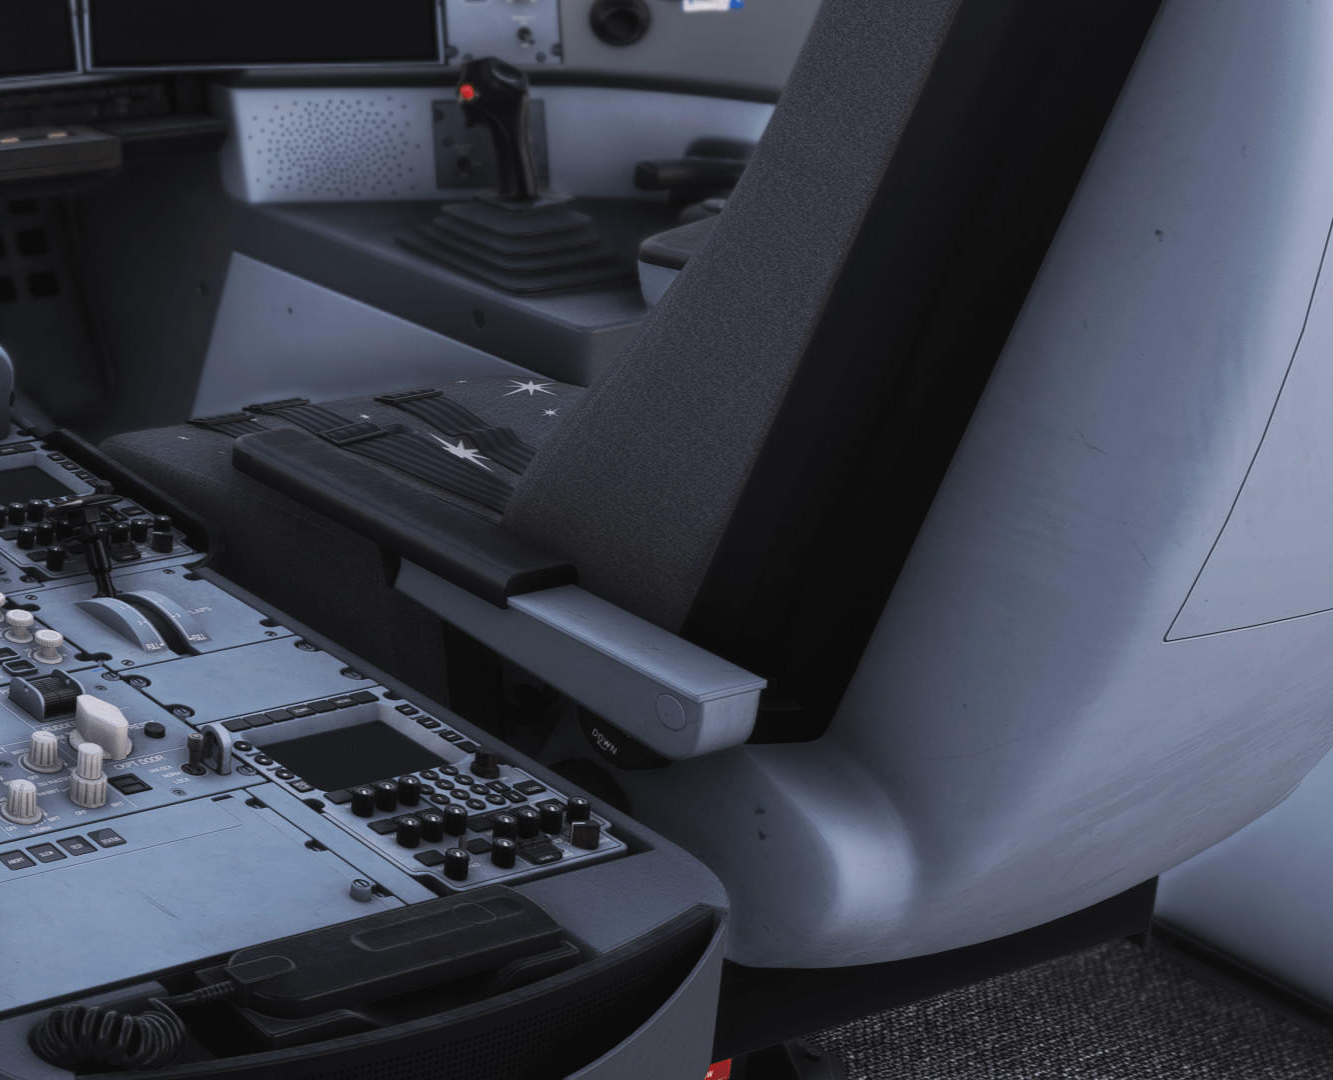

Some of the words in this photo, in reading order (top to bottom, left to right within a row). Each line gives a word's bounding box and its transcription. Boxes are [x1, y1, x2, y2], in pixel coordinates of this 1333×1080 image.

[145, 642, 162, 650] FULL
[592, 728, 617, 755] DOWN
[114, 759, 140, 770] CKPT
[140, 755, 166, 766] DOOR
[148, 765, 174, 774] UNLOCK
[28, 825, 53, 834] STORM
